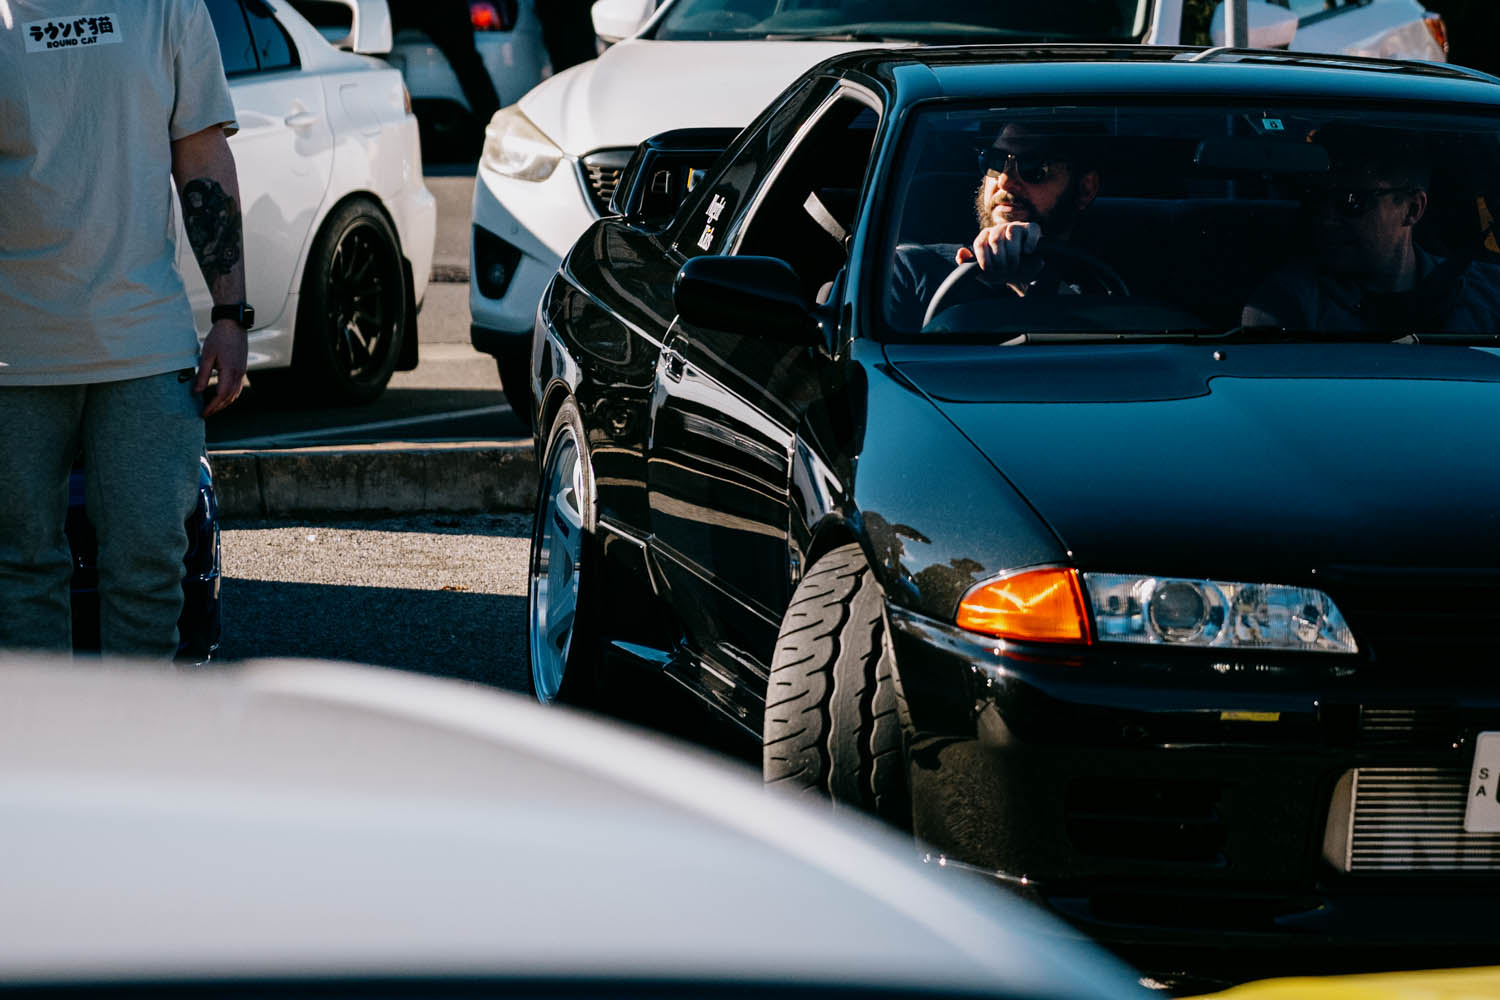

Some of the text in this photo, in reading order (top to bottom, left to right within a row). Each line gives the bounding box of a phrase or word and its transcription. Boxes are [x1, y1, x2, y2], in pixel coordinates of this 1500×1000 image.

[29, 16, 114, 42] ラウンド猫
[46, 35, 98, 49] ROUND CAT
